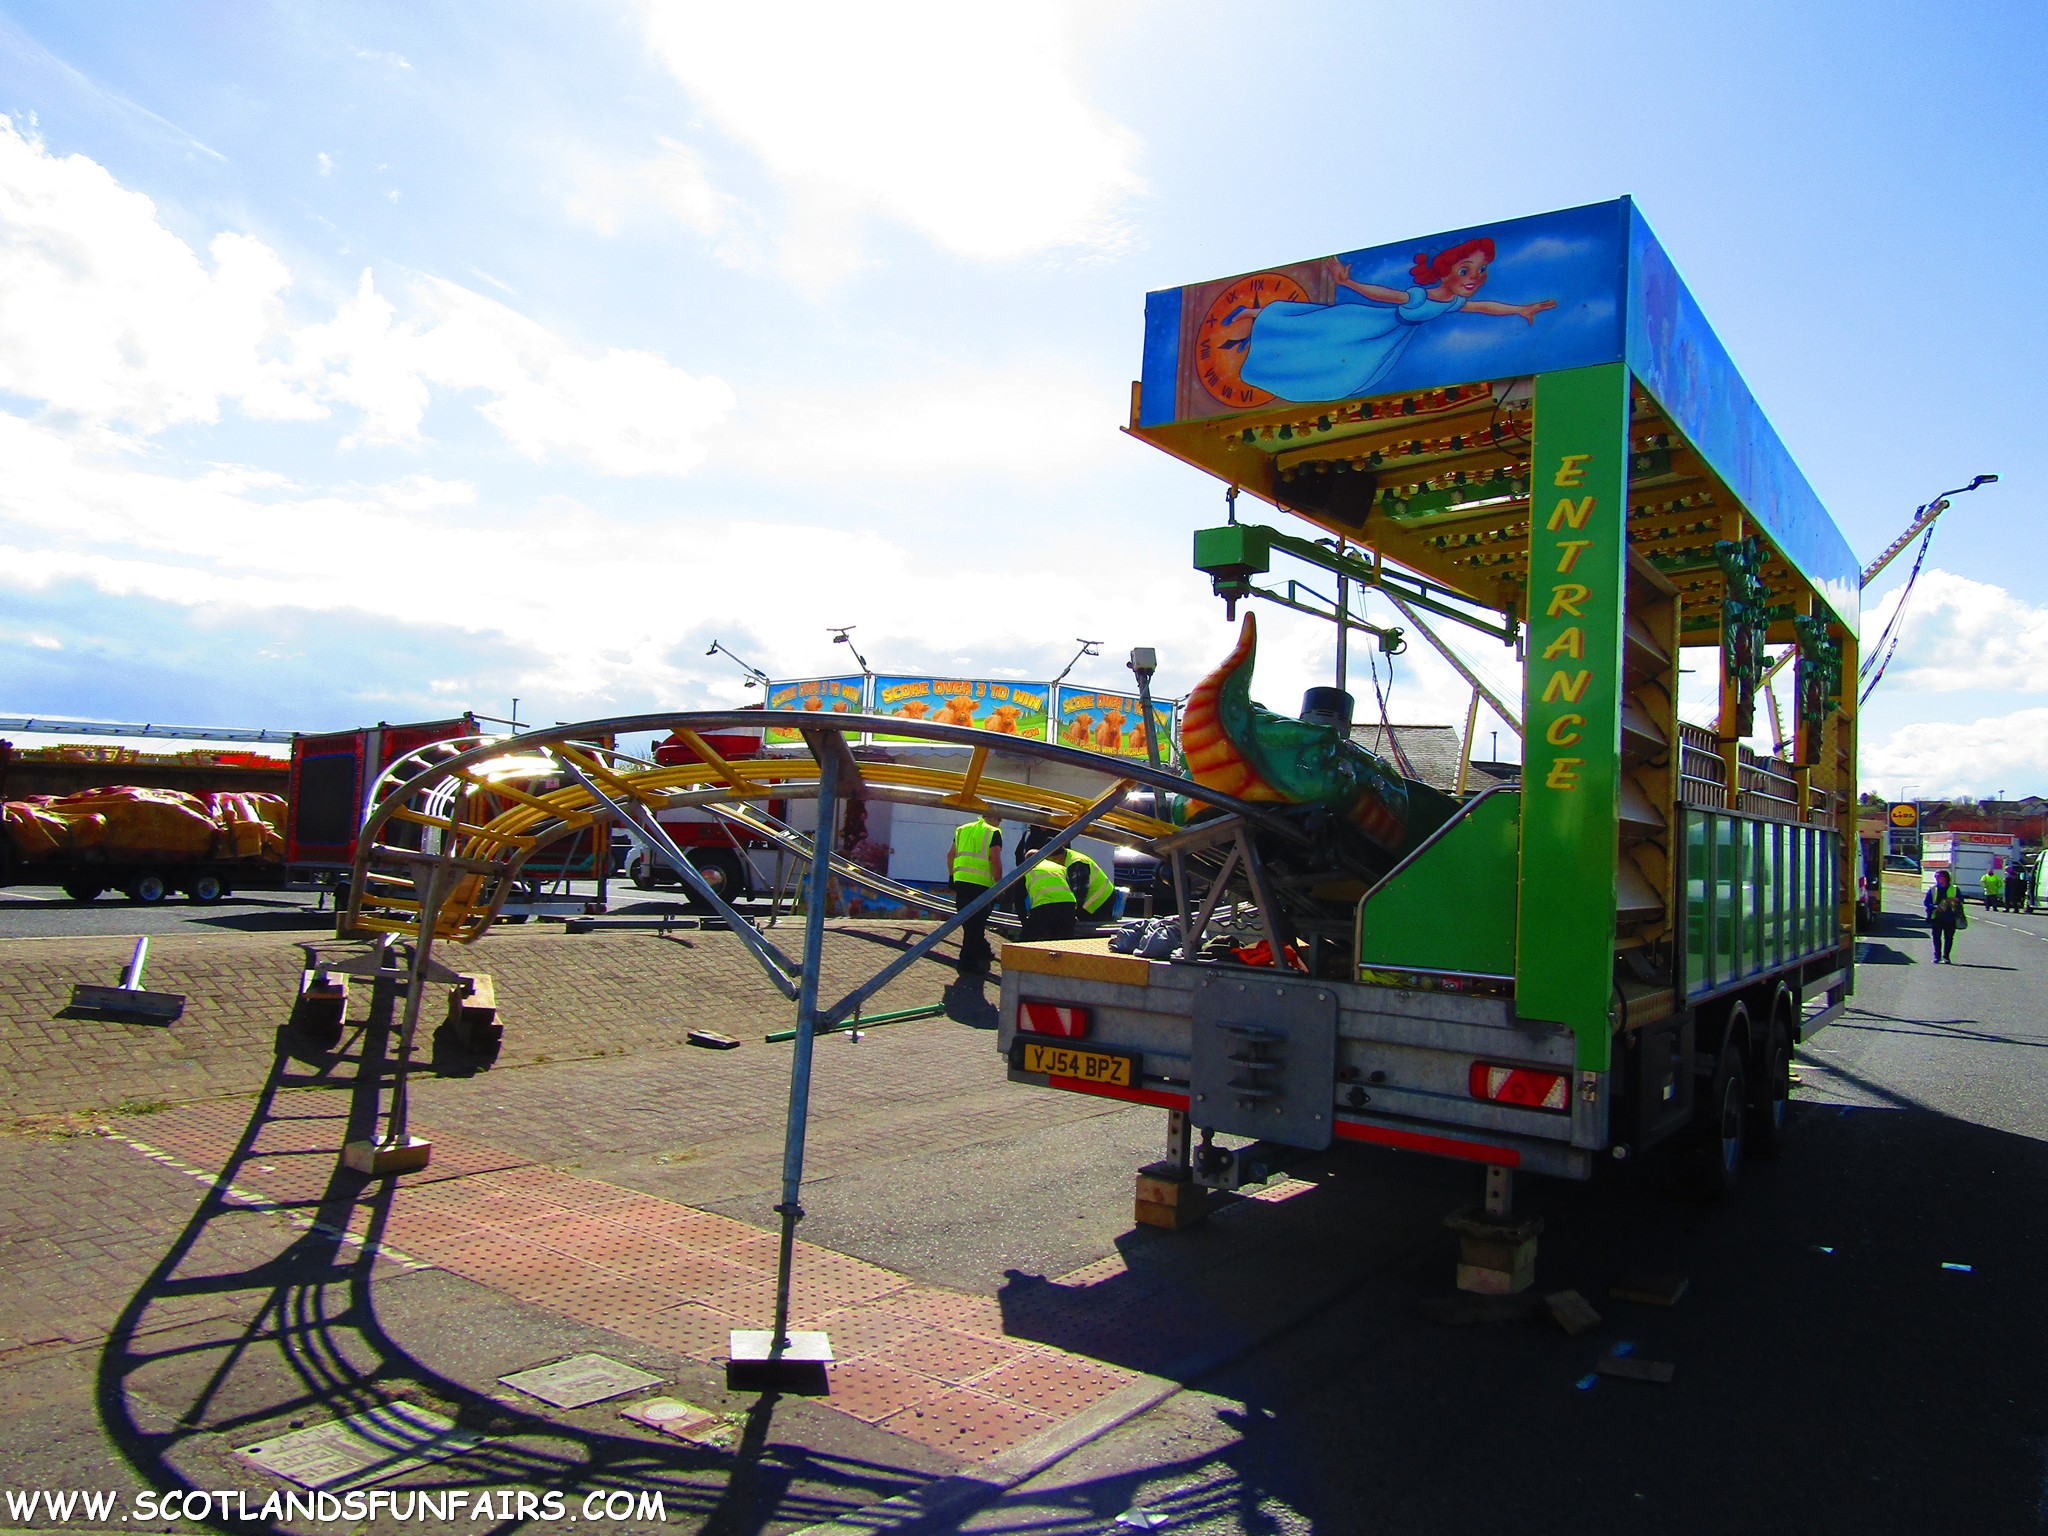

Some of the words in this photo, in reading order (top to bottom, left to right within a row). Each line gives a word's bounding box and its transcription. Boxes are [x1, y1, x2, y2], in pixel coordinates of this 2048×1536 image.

[1542, 454, 1597, 791] ENTRANCE
[881, 682, 930, 704] SCORE
[933, 681, 973, 696] OVER
[976, 682, 986, 697] 3
[990, 683, 1010, 700] TO
[1013, 689, 1043, 710] WIN
[1062, 694, 1095, 714] SCORE
[1096, 693, 1124, 711] OVER
[1124, 697, 1132, 714] 3
[1080, 741, 1101, 753] PLAYER
[1102, 745, 1116, 756] WINS
[1971, 835, 2010, 844] Chips
[1034, 1049, 1080, 1075] YJ54
[1085, 1057, 1122, 1082] BPZ
